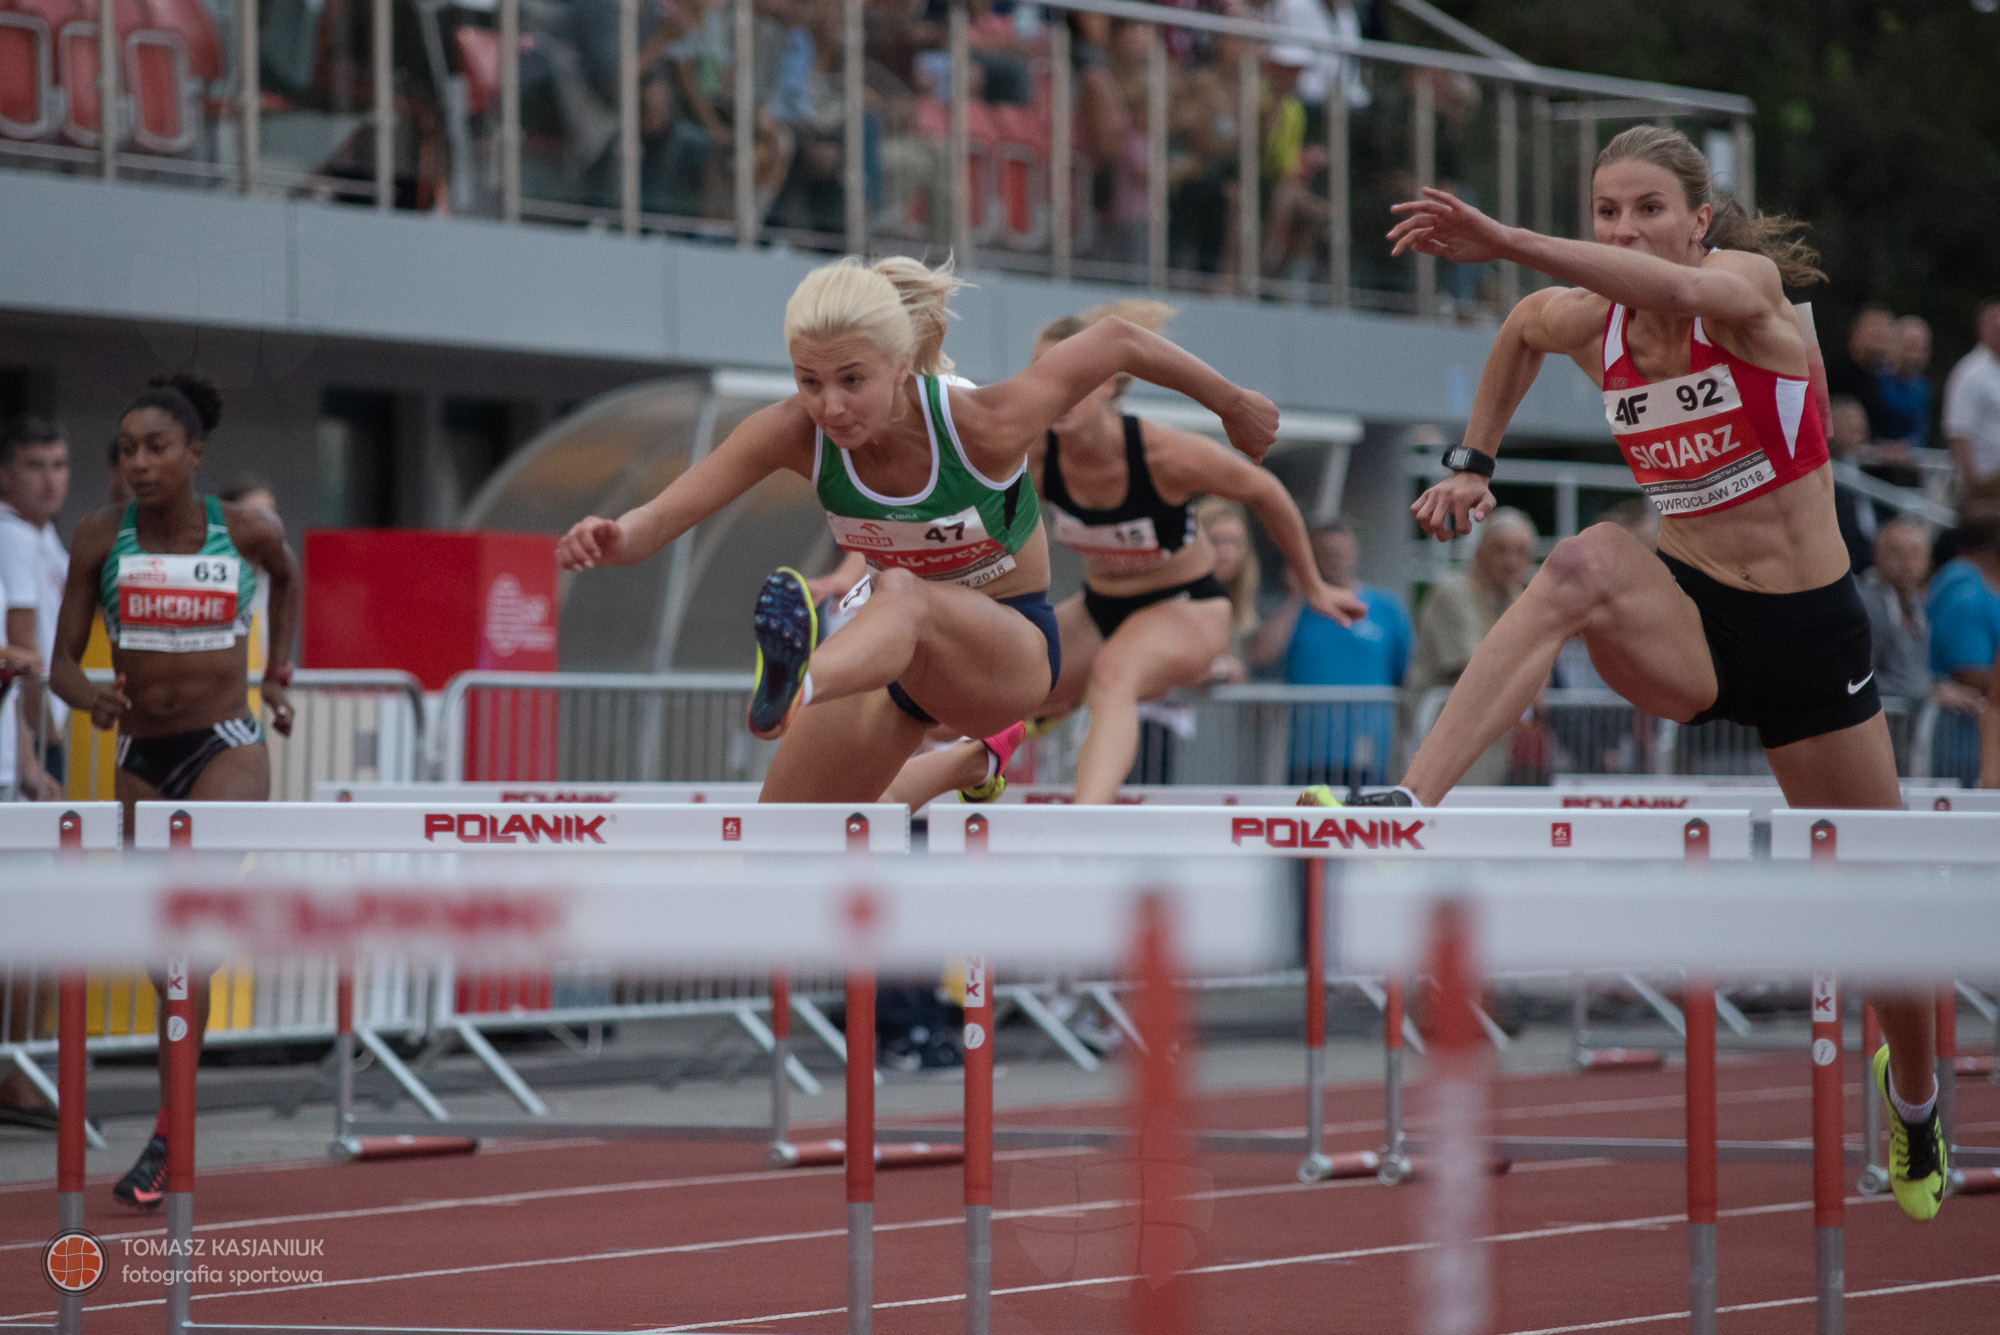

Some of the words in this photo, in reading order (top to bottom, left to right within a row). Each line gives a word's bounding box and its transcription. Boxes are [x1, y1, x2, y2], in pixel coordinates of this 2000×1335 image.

[1676, 378, 1724, 411] 92
[1630, 424, 1741, 470] SICIARZ
[1654, 487, 1730, 512] OWROCŁAW
[1732, 470, 1765, 493] 2018
[924, 521, 965, 543] 47
[194, 562, 226, 582] 63
[975, 564, 1006, 585] 2018
[424, 813, 606, 844] POLANIK
[1231, 817, 1426, 850] POLANIK
